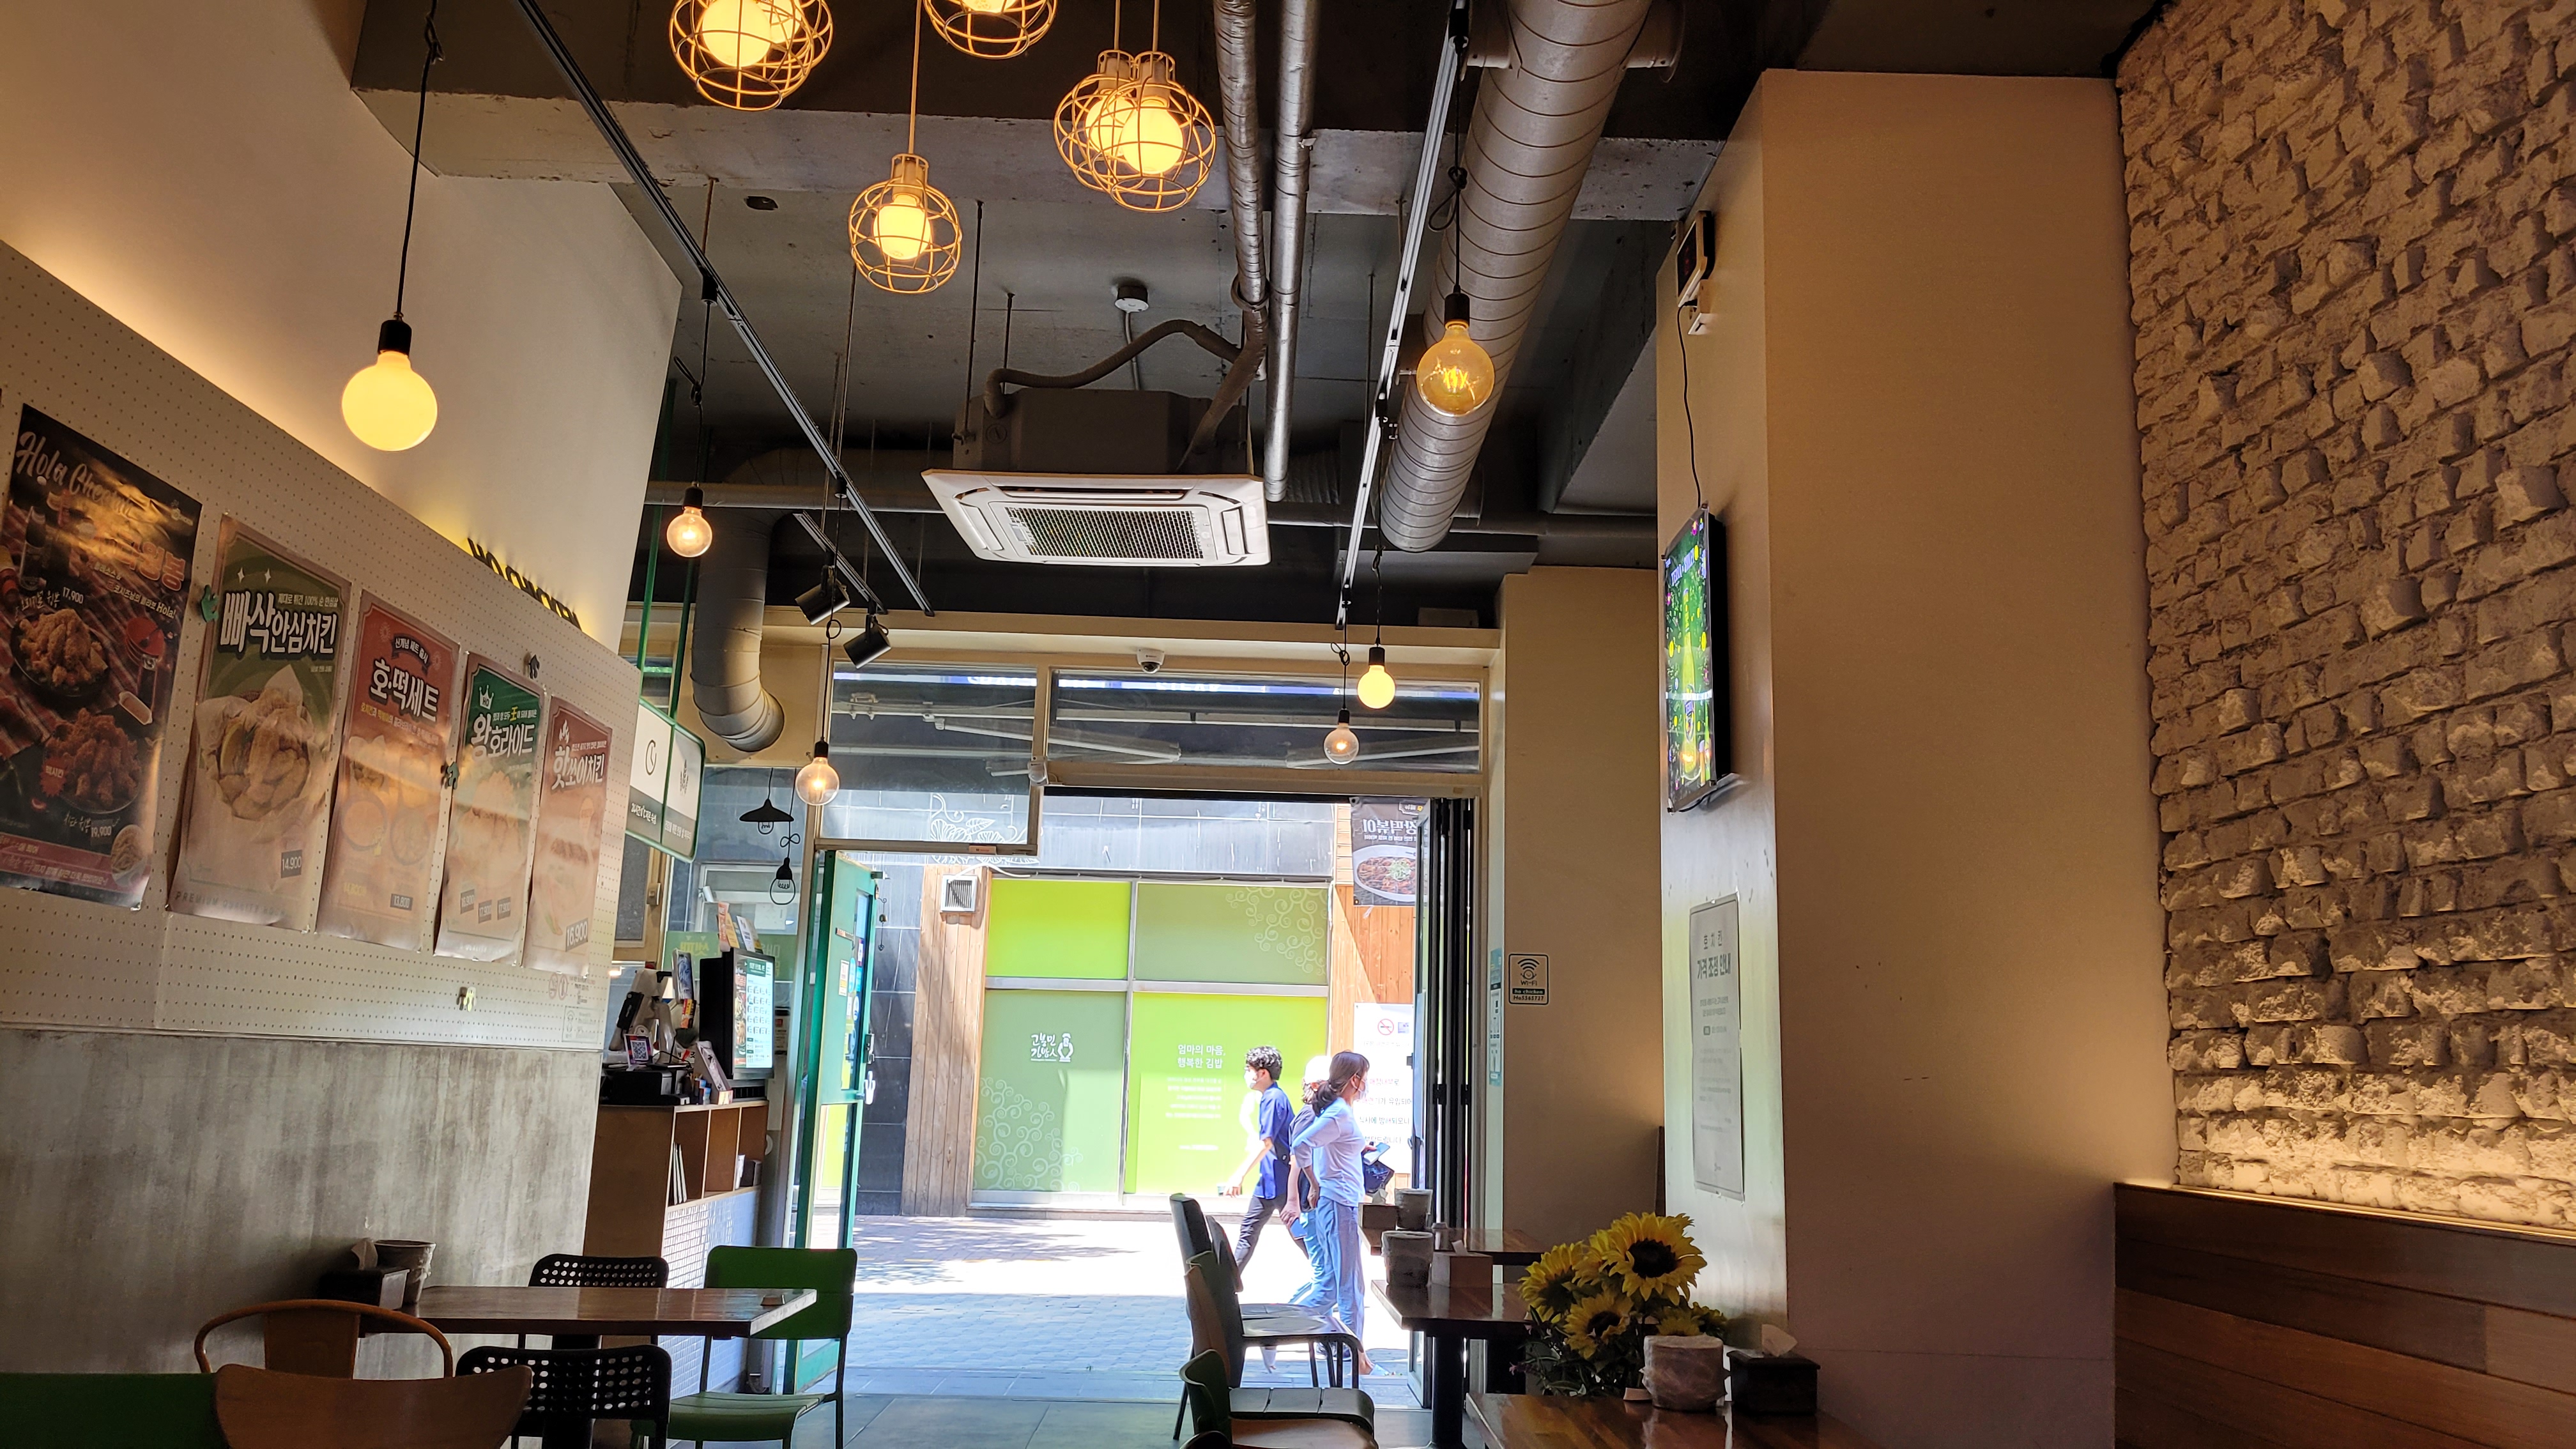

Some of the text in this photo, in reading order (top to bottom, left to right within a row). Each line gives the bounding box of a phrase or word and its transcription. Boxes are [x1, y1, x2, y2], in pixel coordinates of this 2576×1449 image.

[16, 431, 68, 486] Hola
[304, 595, 318, 607] 100%
[156, 602, 176, 619] Hola!
[482, 697, 490, 707] HO
[174, 891, 219, 905] PREMIUM
[566, 921, 588, 947] 16,900
[1697, 952, 1731, 980] 가격 조정 안내
[1177, 1044, 1226, 1057] 엄마의 마음,
[1177, 1057, 1223, 1069] 행복한 김밥
